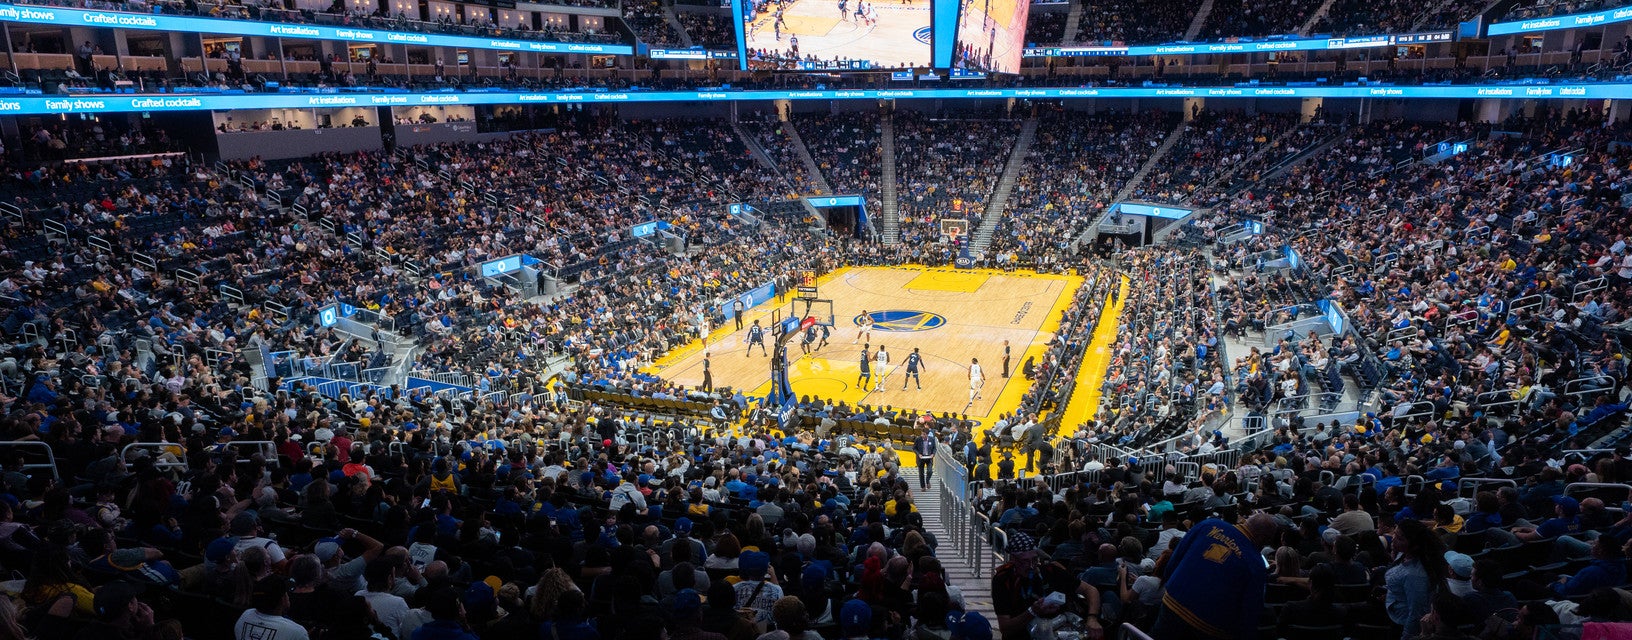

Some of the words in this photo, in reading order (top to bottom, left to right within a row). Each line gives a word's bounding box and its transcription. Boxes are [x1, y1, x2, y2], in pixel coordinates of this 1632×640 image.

[22, 9, 54, 20] shows
[84, 13, 118, 24] Crafted
[119, 16, 156, 26] cocktails
[336, 30, 354, 39] Family
[46, 100, 72, 111] Family
[74, 100, 104, 108] shows
[132, 99, 164, 107] Crafted
[165, 98, 201, 106] cocktails
[372, 96, 390, 105] Family
